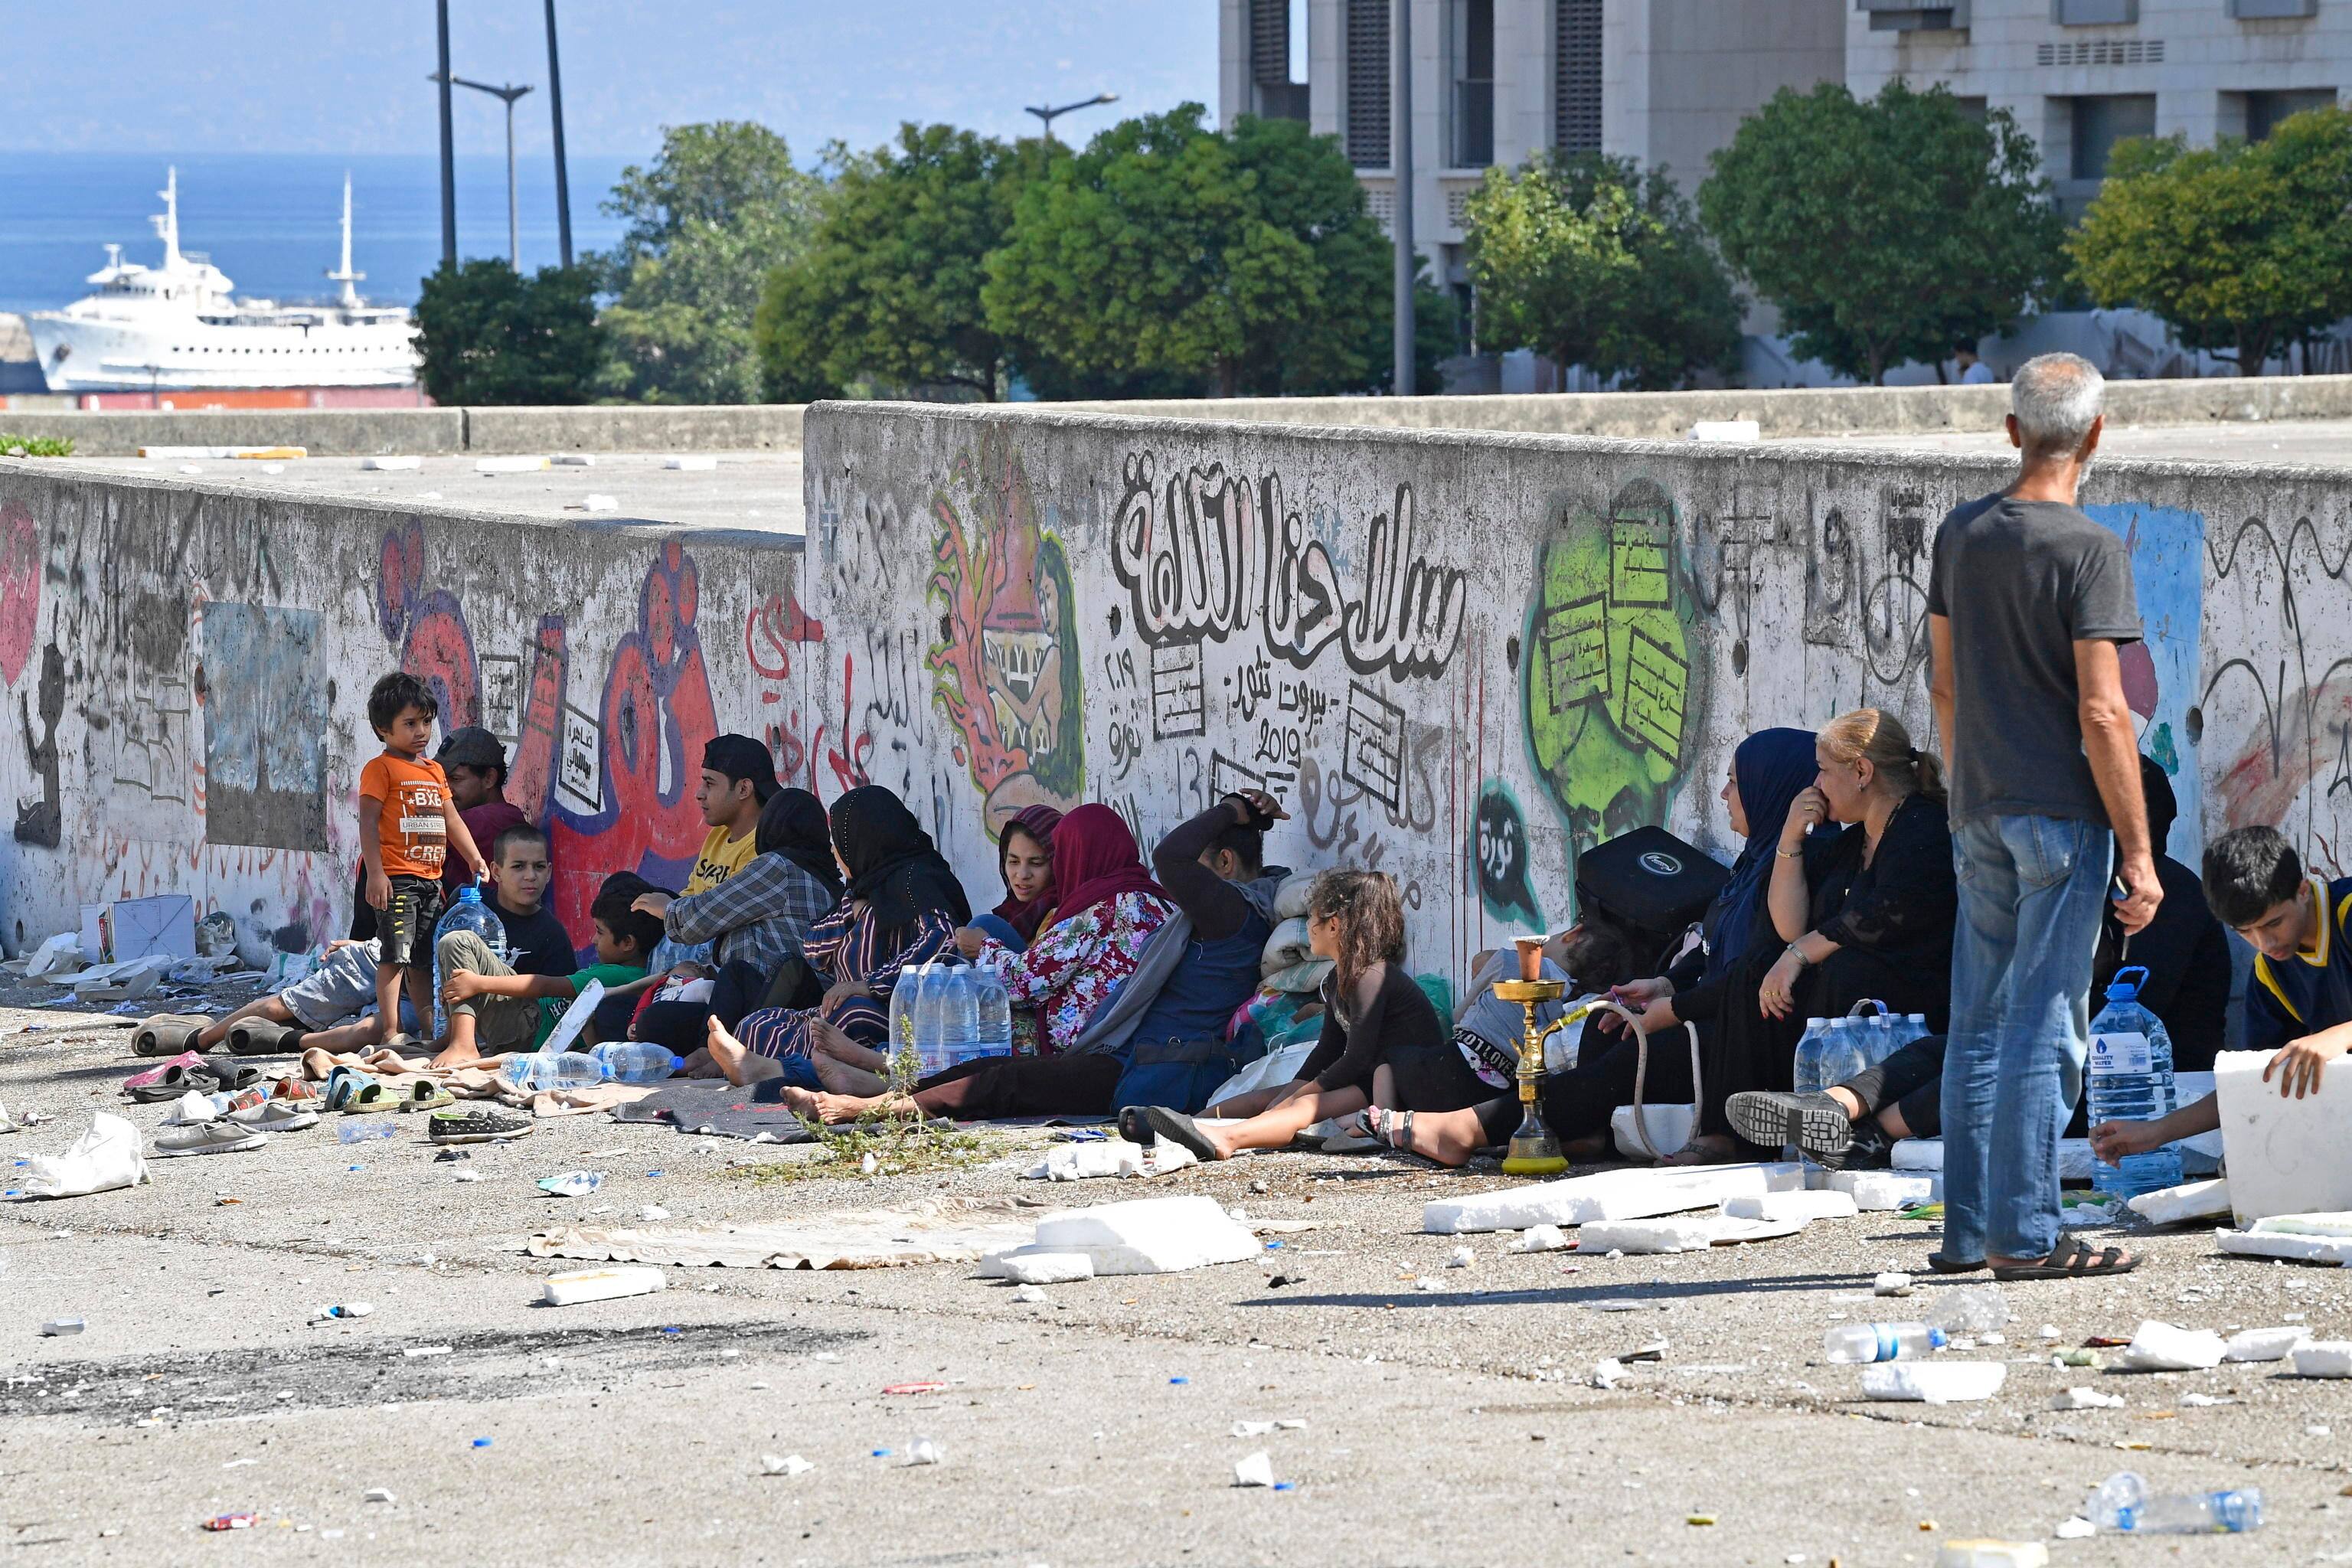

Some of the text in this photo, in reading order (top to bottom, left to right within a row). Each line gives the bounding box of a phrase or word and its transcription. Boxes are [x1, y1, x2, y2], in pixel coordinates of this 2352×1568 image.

[1277, 679, 1327, 738] بيروت
[1108, 697, 1142, 782] ثورة
[1255, 717, 1302, 769] 2019
[1480, 816, 1513, 880] ثورة
